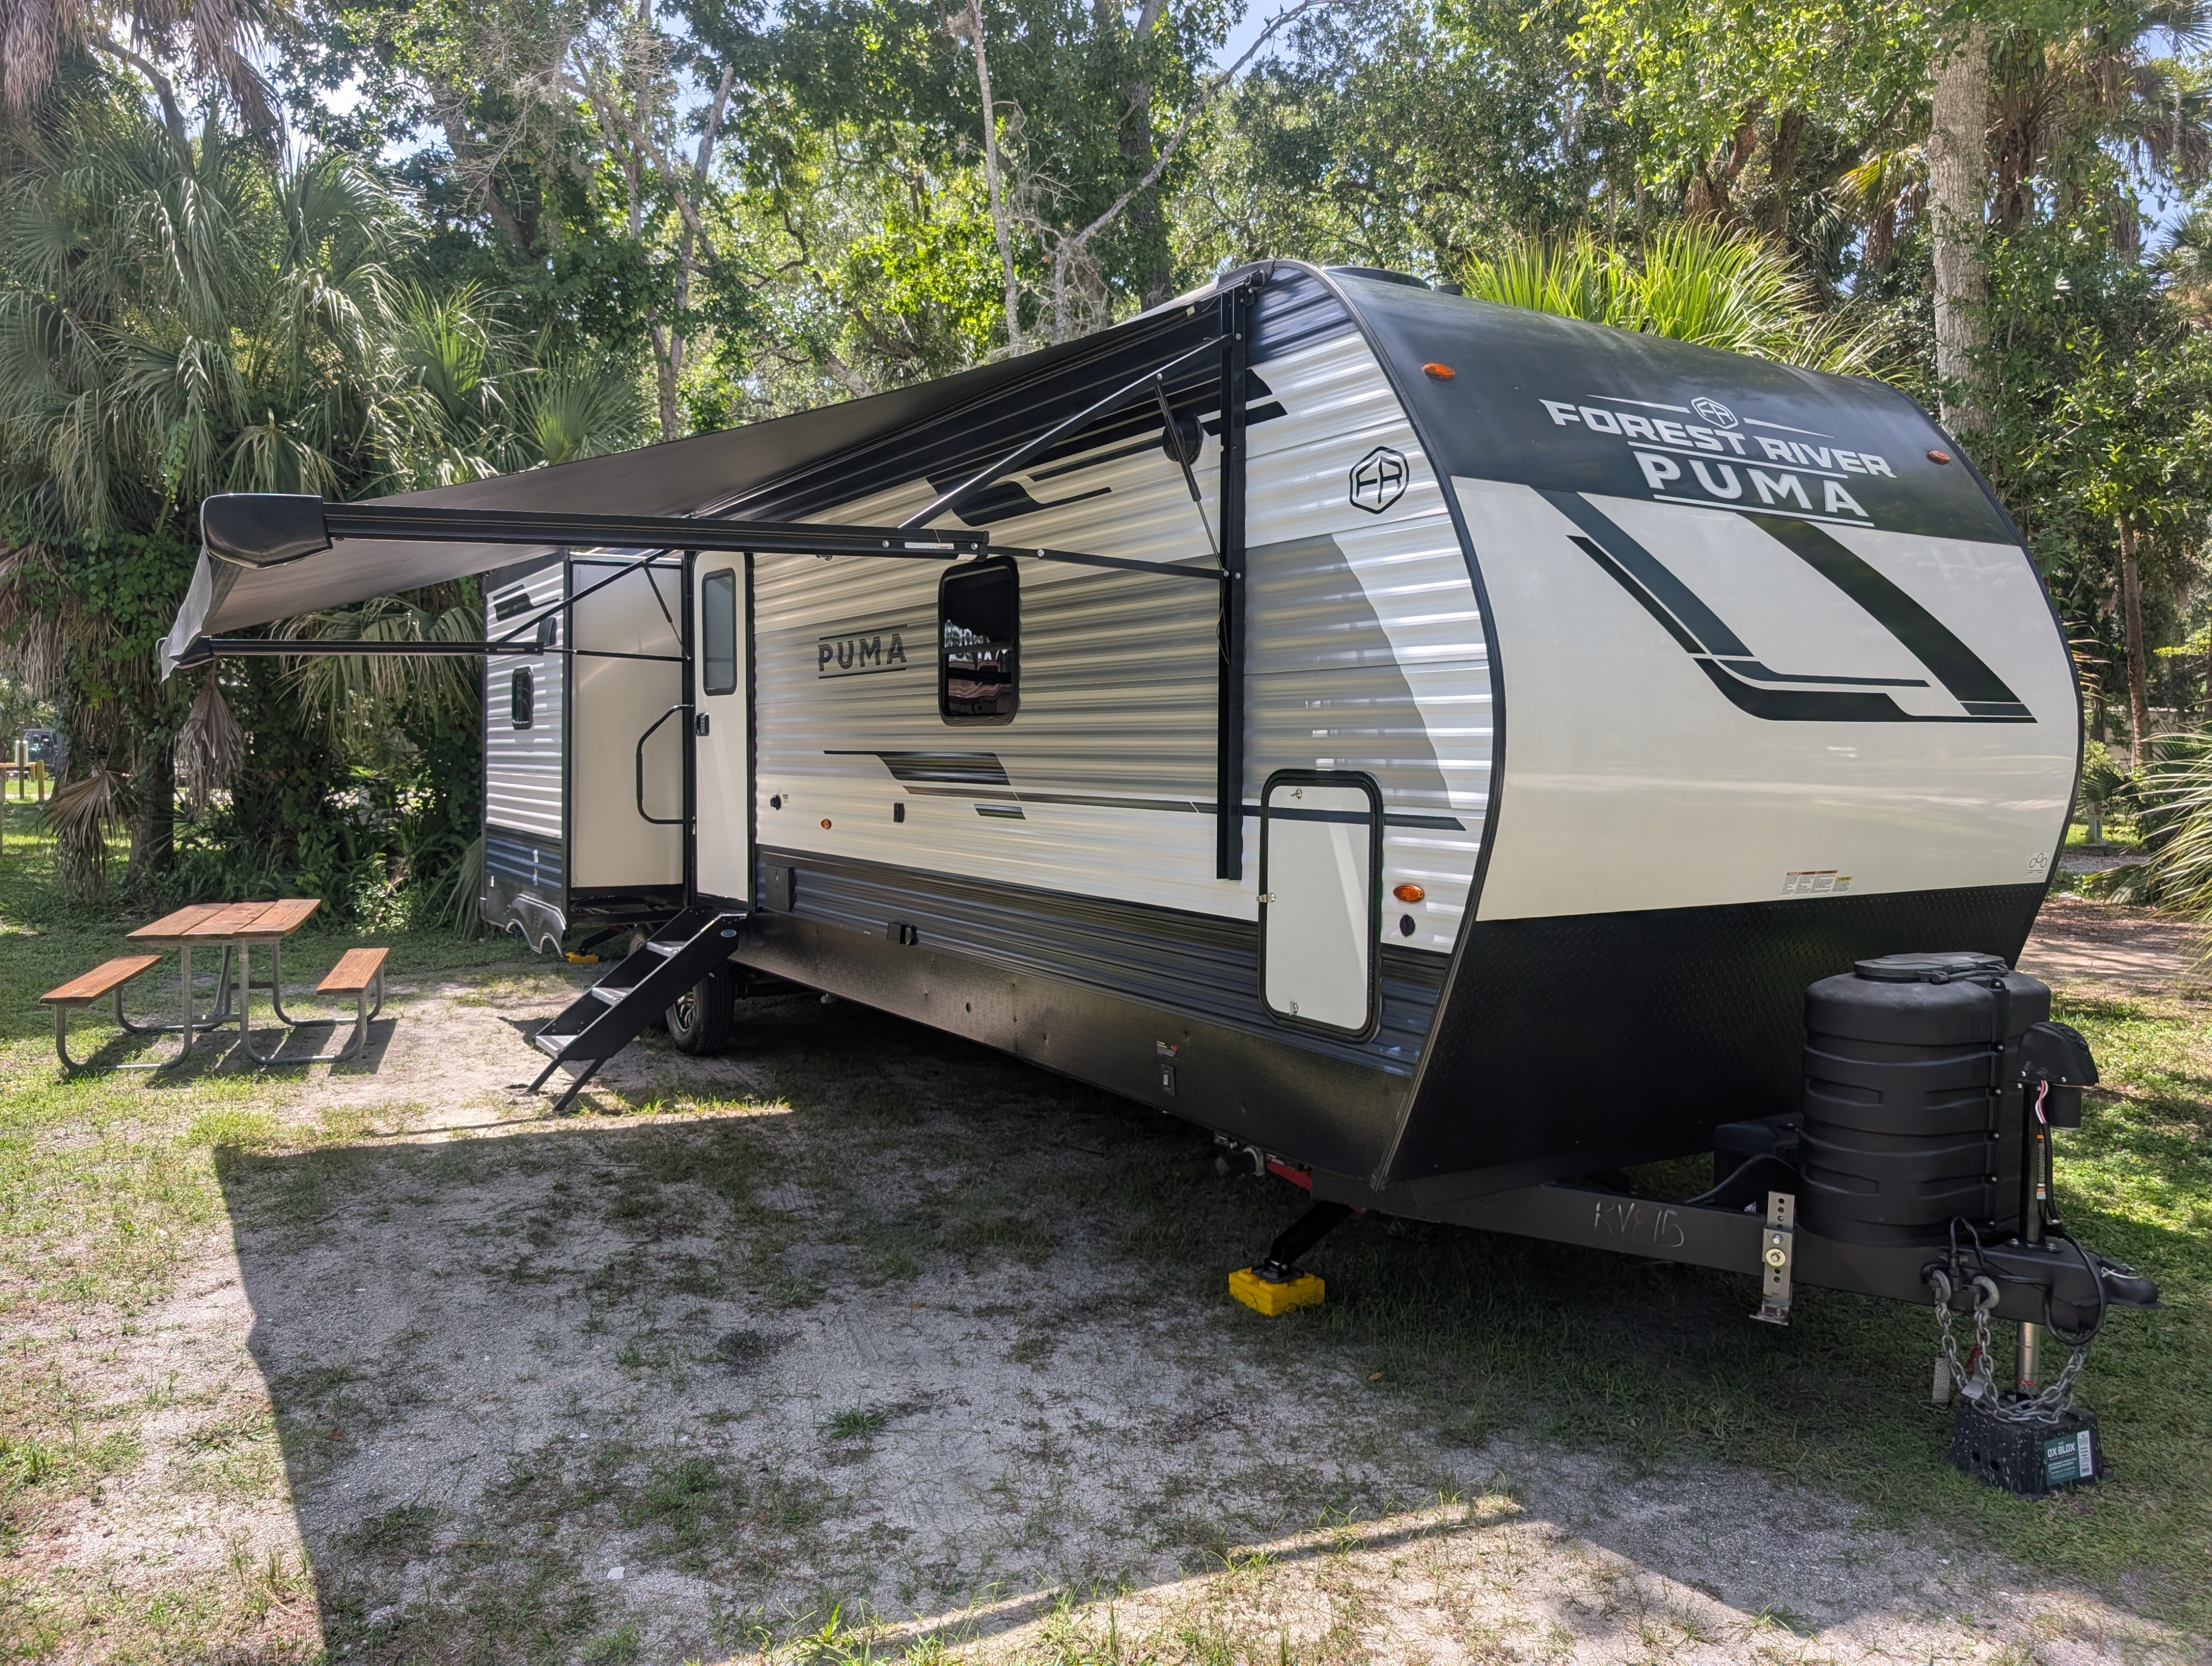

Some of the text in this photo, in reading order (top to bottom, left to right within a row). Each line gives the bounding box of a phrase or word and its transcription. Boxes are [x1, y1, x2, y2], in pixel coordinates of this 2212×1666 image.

[1538, 399, 1897, 478] FOREST RIVER
[1632, 451, 1870, 518] PUMA
[818, 633, 907, 672] PUMA
[2047, 1446, 2058, 1458] OX
[2058, 1442, 2076, 1455] BLOX
